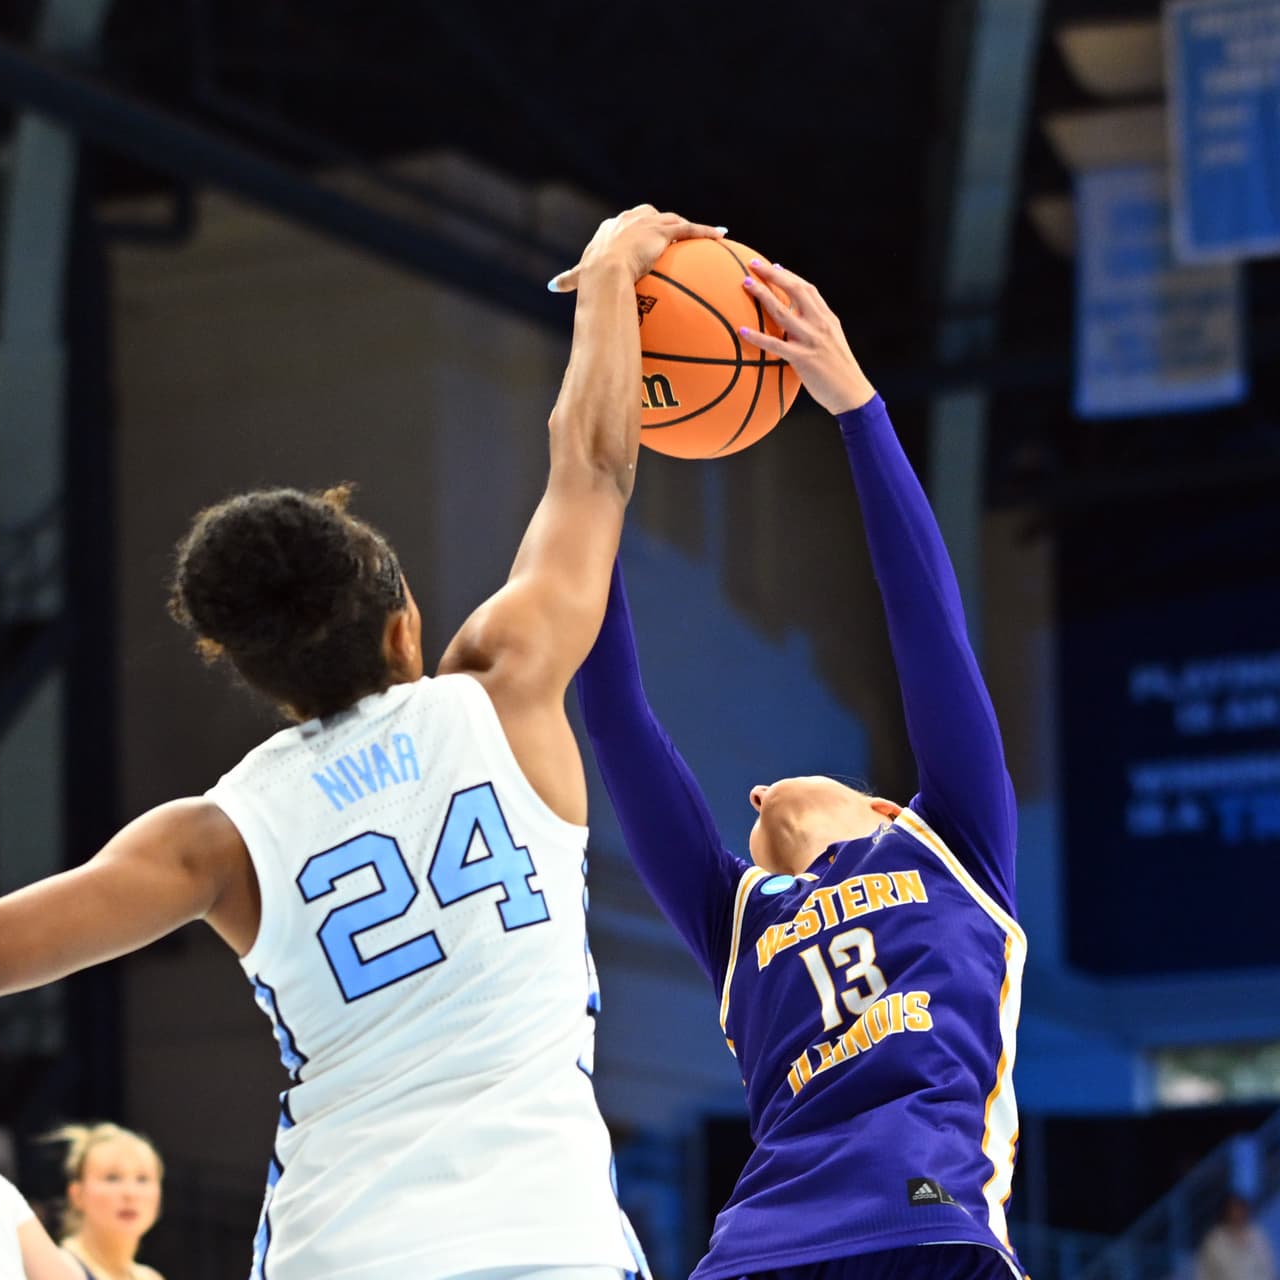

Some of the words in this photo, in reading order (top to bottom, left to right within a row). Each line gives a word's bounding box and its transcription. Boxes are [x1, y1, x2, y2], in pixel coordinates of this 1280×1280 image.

[312, 733, 420, 812] NIVAR
[296, 781, 551, 1004] 24
[756, 870, 928, 972] WESTERN
[798, 926, 889, 1033] 13
